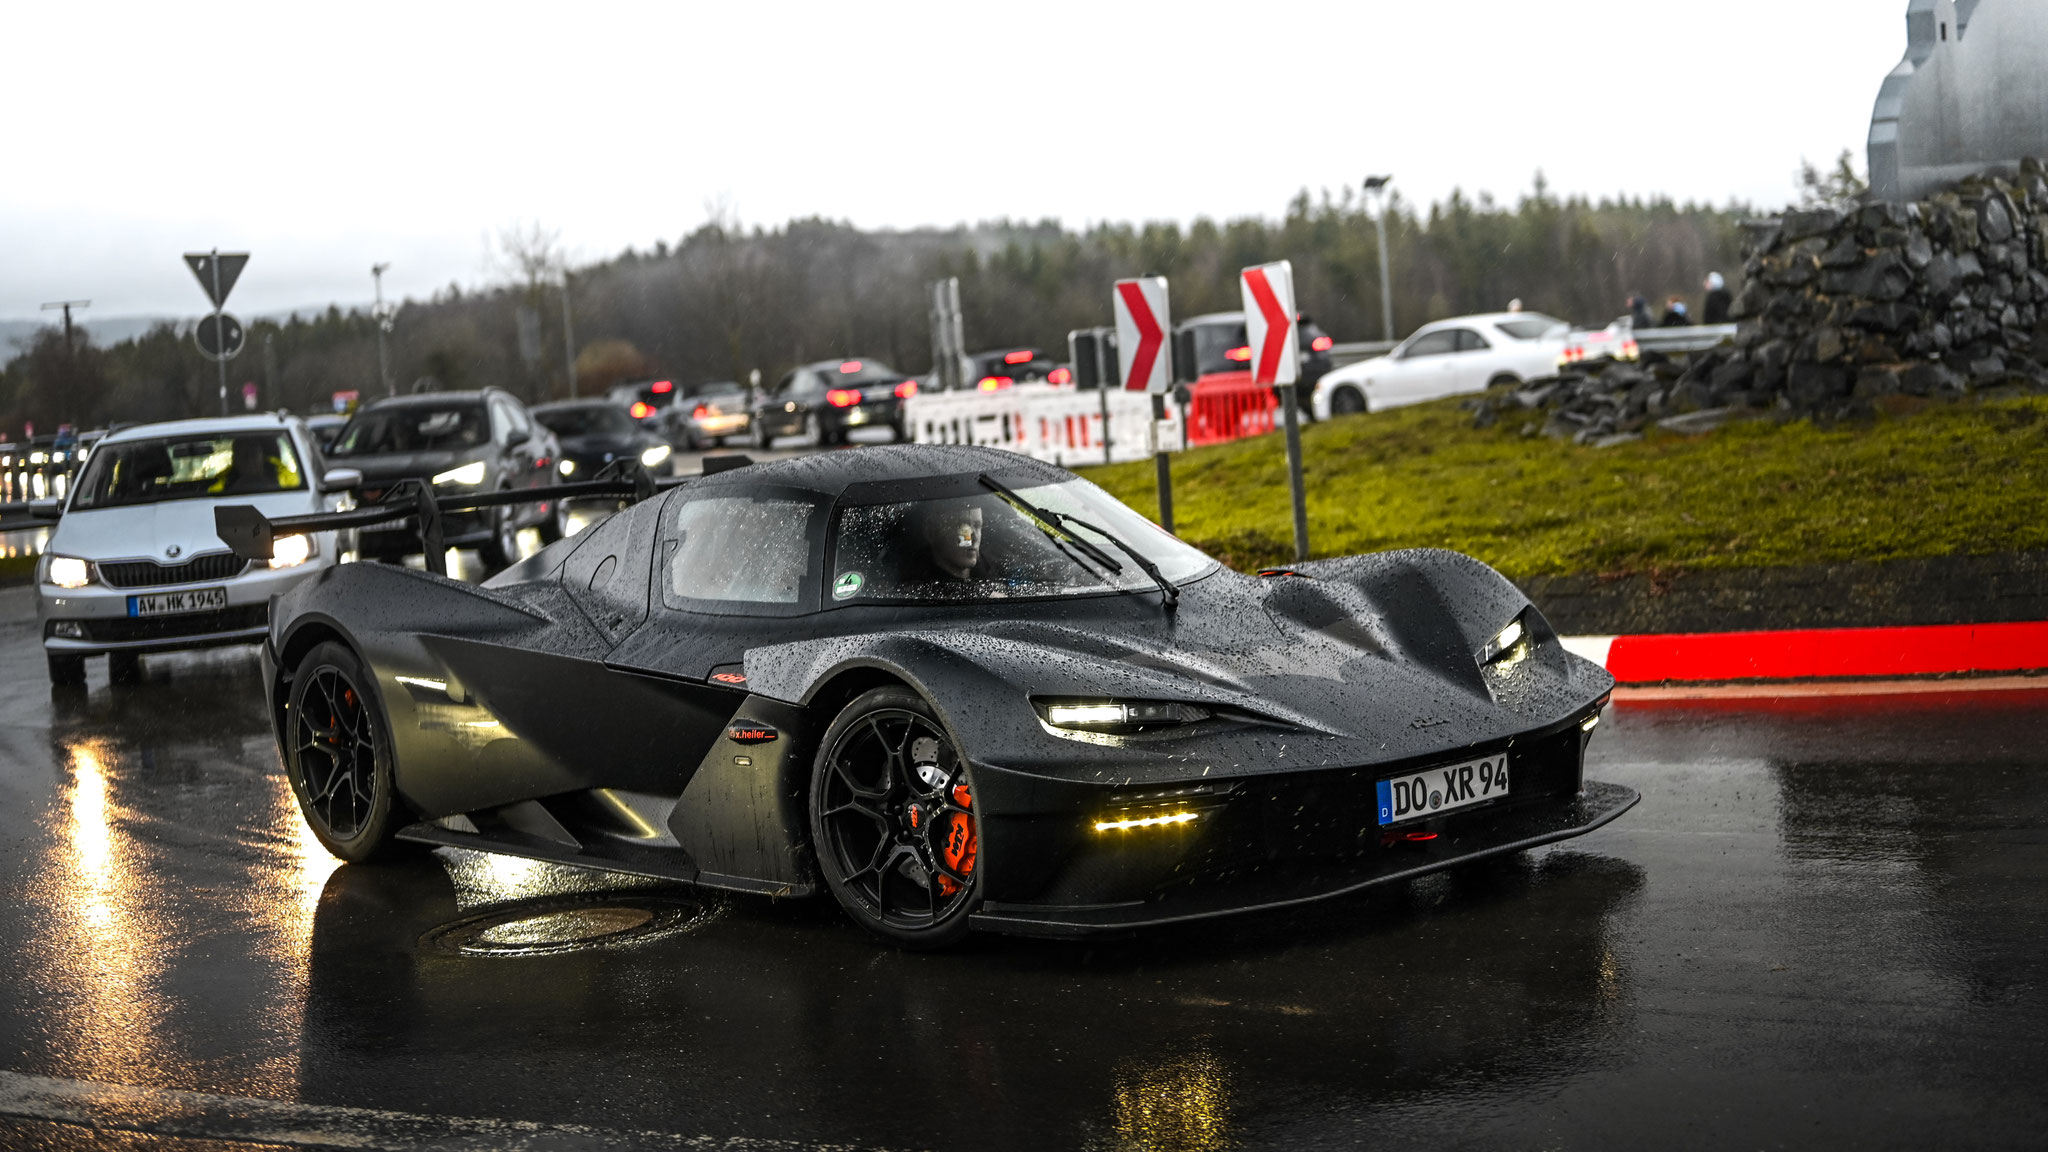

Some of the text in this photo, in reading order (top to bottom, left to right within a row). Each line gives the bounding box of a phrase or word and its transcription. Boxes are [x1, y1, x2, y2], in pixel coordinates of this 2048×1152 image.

[139, 590, 223, 612] AW HK 1945
[1393, 757, 1507, 816] DO XR 94
[1381, 807, 1389, 818] D
[951, 823, 964, 857] KTM
